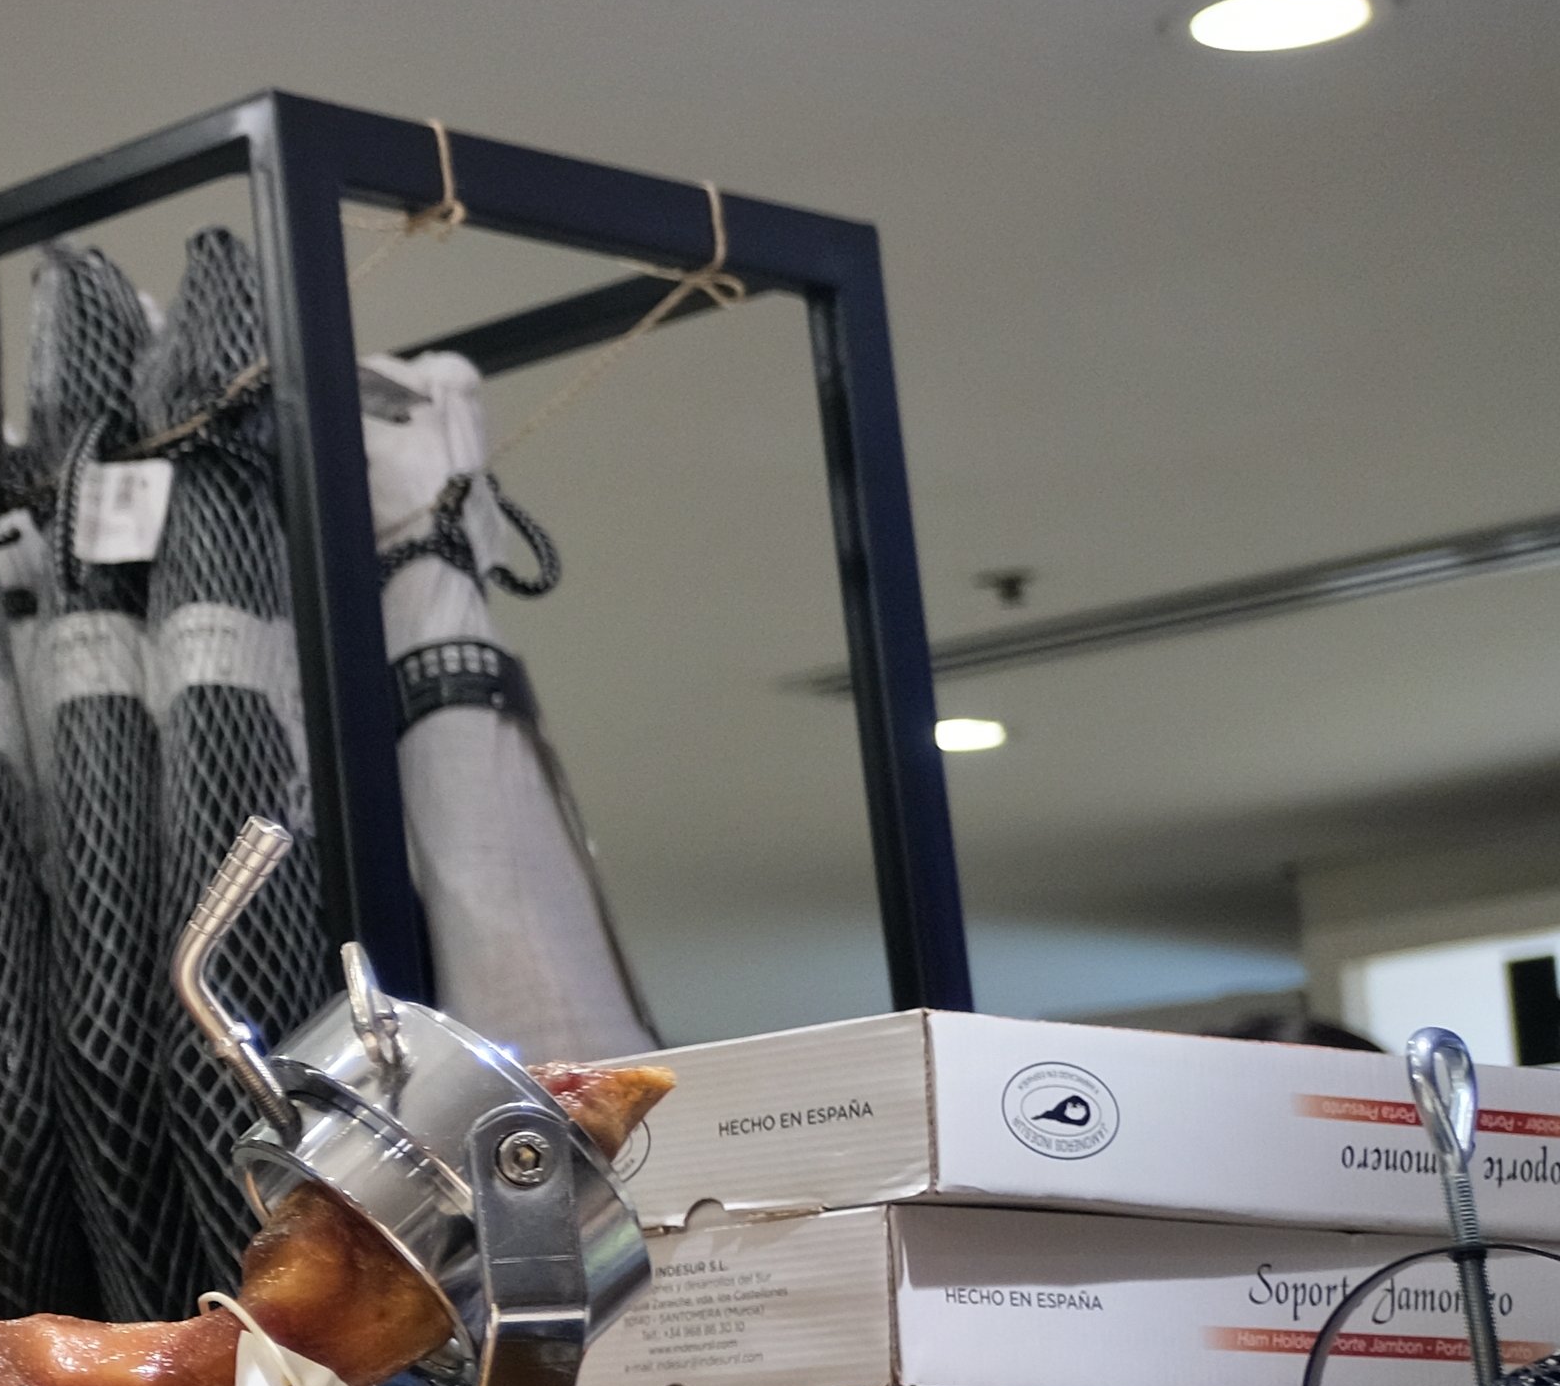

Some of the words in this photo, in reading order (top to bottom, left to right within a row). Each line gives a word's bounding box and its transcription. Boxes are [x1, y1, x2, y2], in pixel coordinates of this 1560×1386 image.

[718, 1115, 776, 1137] HECHO
[780, 1111, 802, 1129] EN
[807, 1098, 874, 1125] ESPAÑA
[1321, 1101, 1379, 1121] Presunto
[1341, 1146, 1437, 1174] monero
[1483, 1146, 1560, 1189] oporte
[654, 1261, 706, 1278] INDESUR
[944, 1287, 1005, 1306] HECHO
[1009, 1290, 1032, 1308] EN
[1037, 1290, 1104, 1311] ESPAÑA
[1248, 1263, 1350, 1321] Soport
[1237, 1333, 1270, 1347] Ham
[1272, 1334, 1313, 1350] Holde
[1369, 1337, 1424, 1355] Jambon
